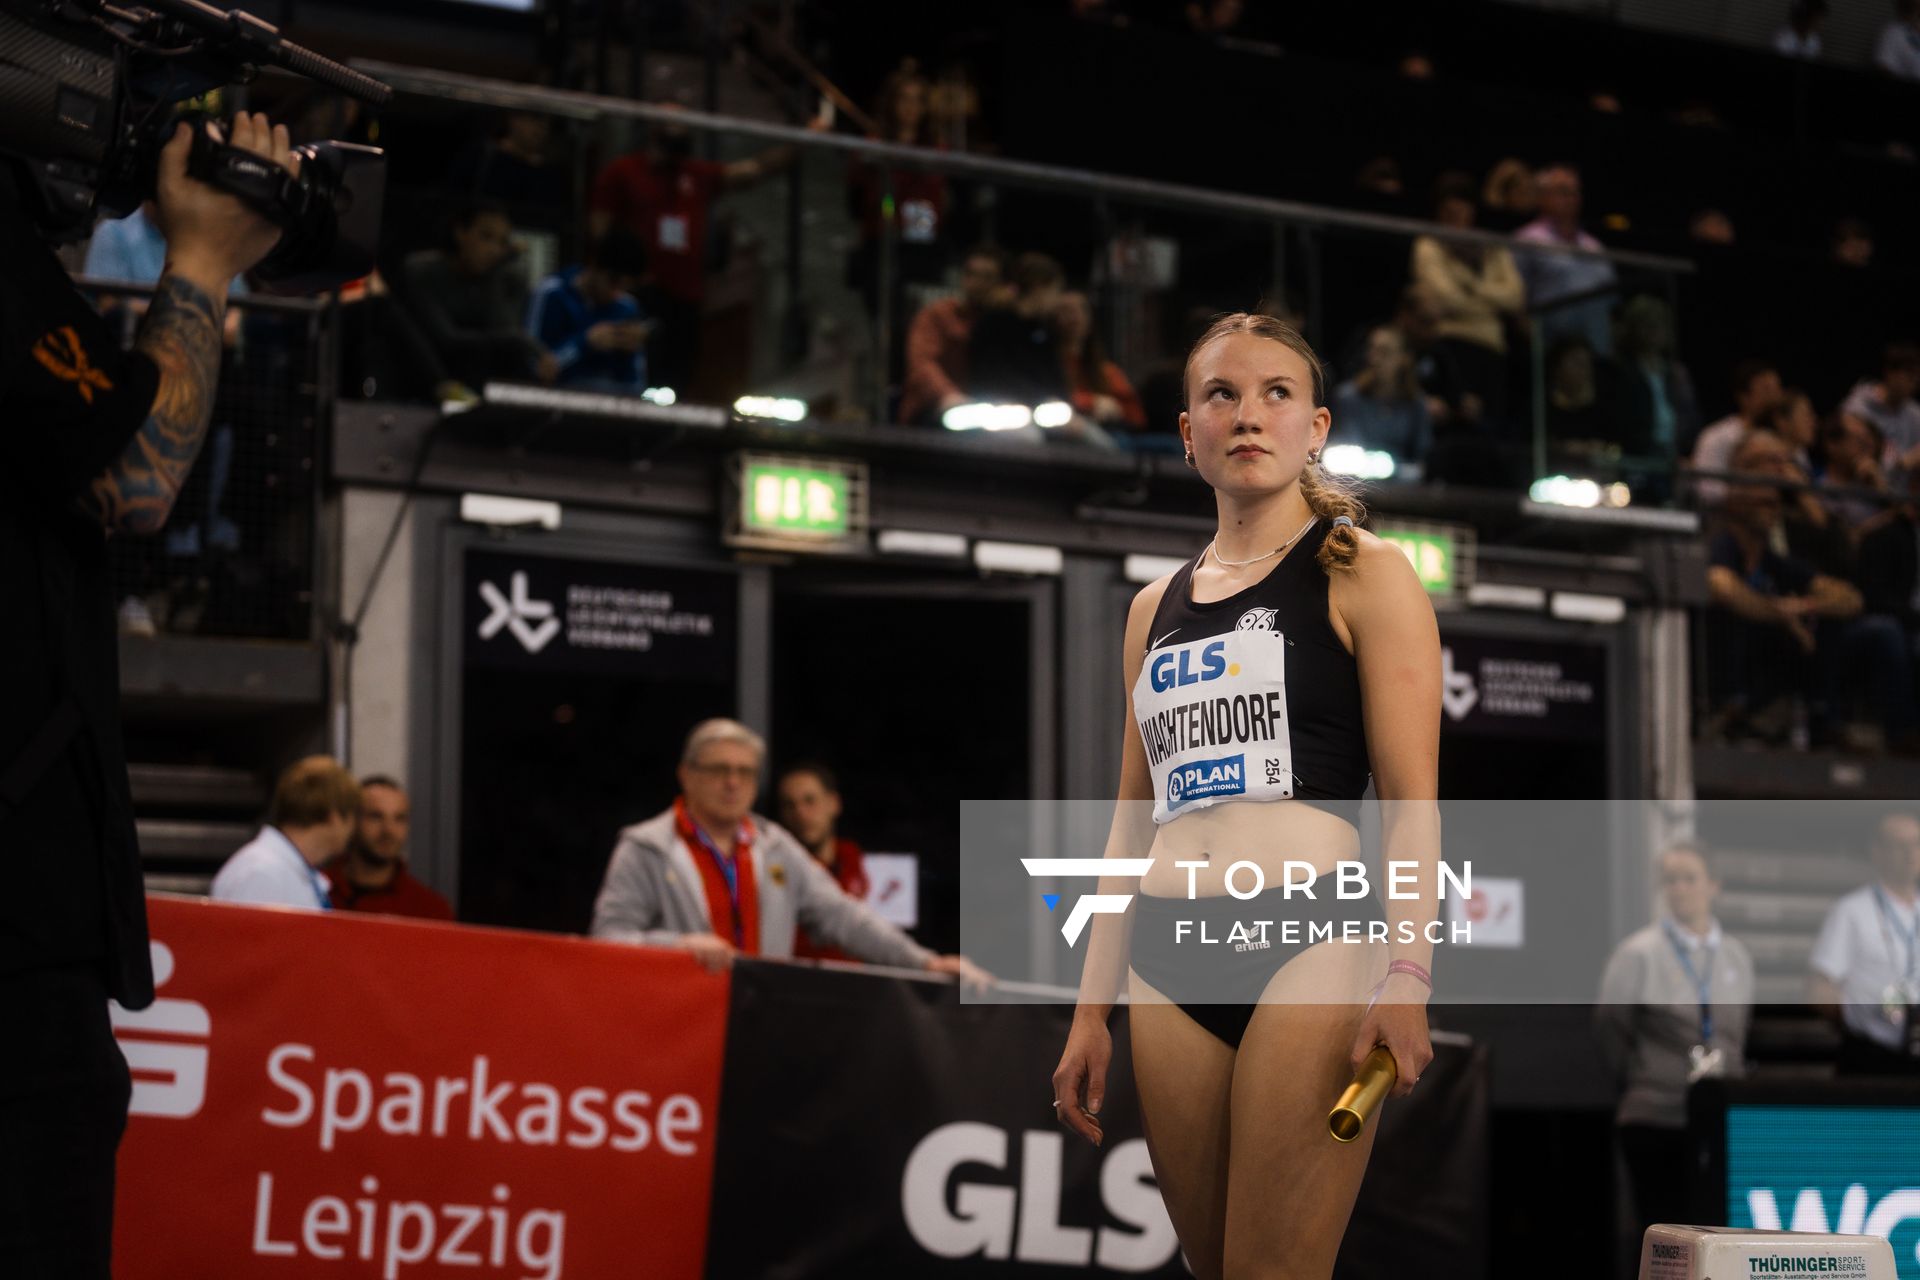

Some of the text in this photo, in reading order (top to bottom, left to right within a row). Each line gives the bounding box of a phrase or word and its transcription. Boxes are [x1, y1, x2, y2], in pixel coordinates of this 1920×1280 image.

[1141, 692, 1281, 767] WACHTENDORF
[1185, 763, 1240, 788] PLAN
[1264, 758, 1281, 785] 254
[1186, 783, 1241, 797] INTERNATIONAL
[261, 1043, 702, 1155] Sparkasse
[252, 1172, 566, 1280] Leipzig
[1749, 1255, 1838, 1273] THÜRINGER
[1838, 1264, 1866, 1272] SERVICE
